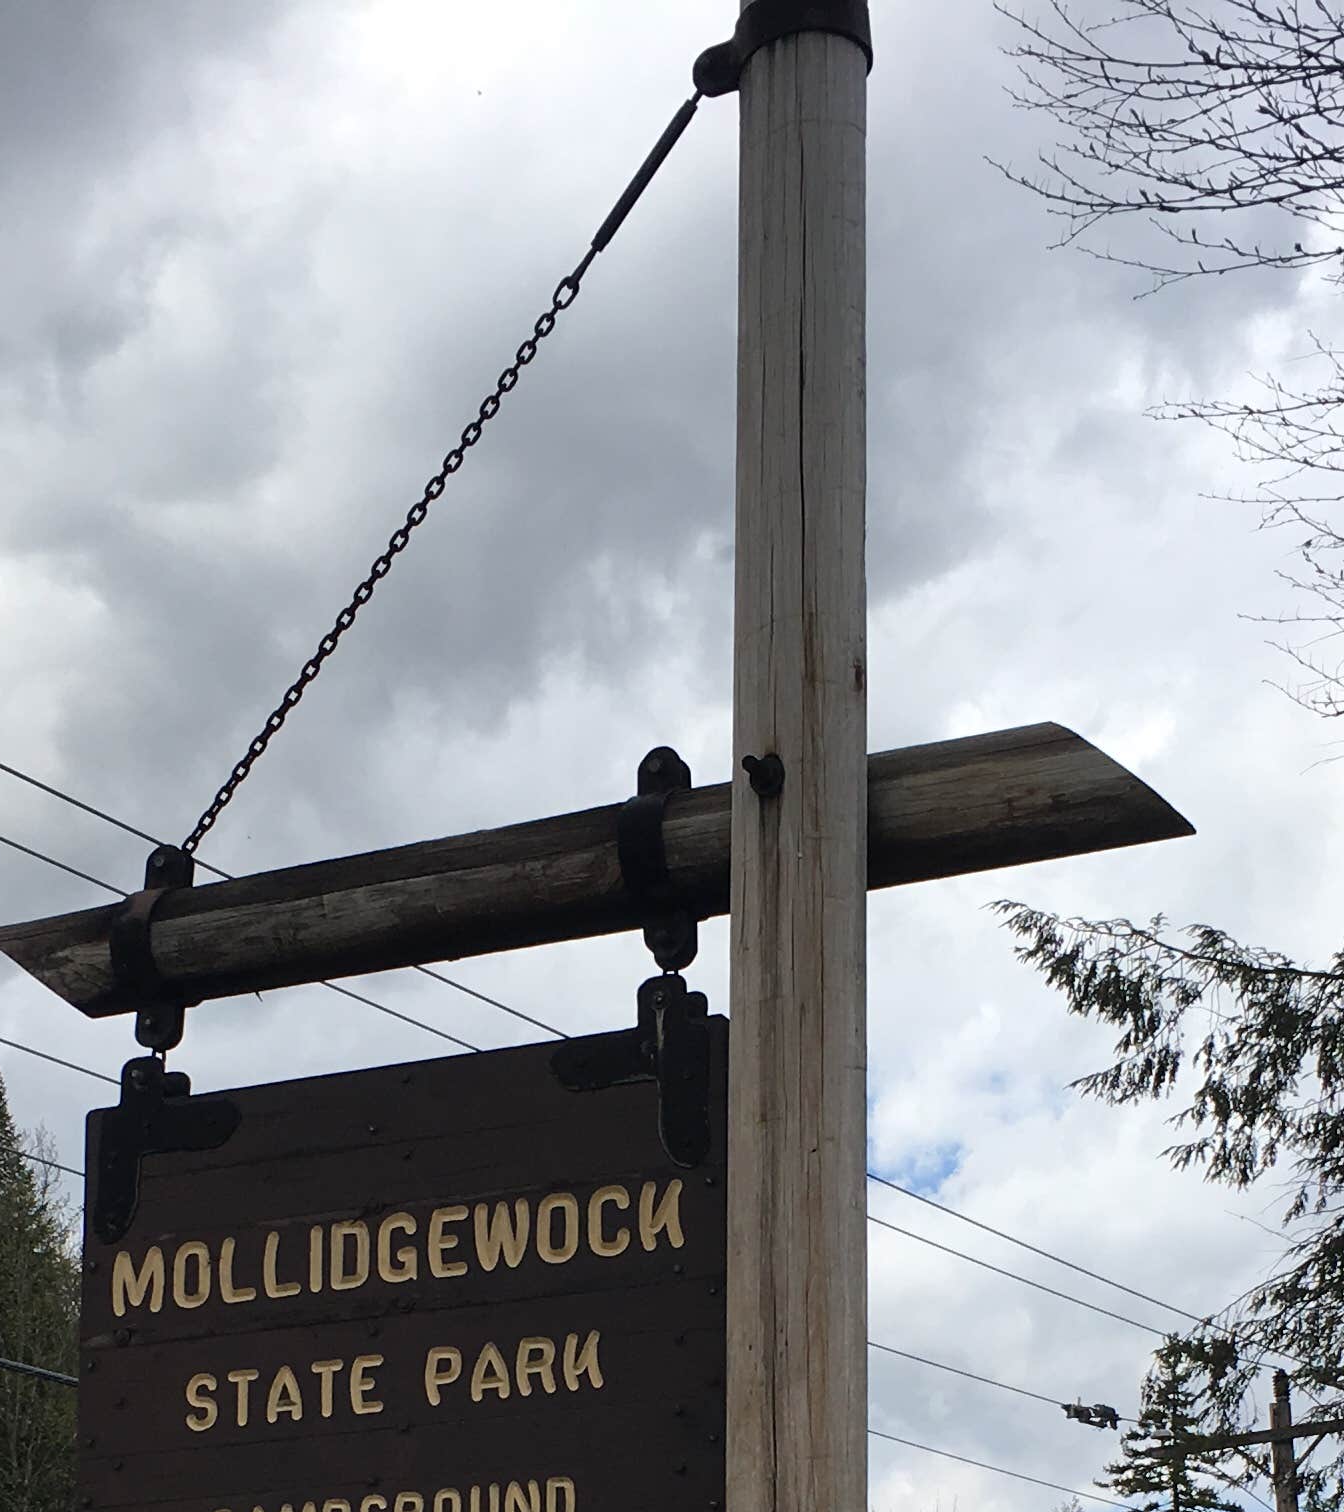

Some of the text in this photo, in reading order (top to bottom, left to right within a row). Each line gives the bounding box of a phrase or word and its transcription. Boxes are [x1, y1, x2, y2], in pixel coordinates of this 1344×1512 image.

[111, 1179, 685, 1317] MOLLIDGEWOCK
[185, 1330, 604, 1432] STATE PARK
